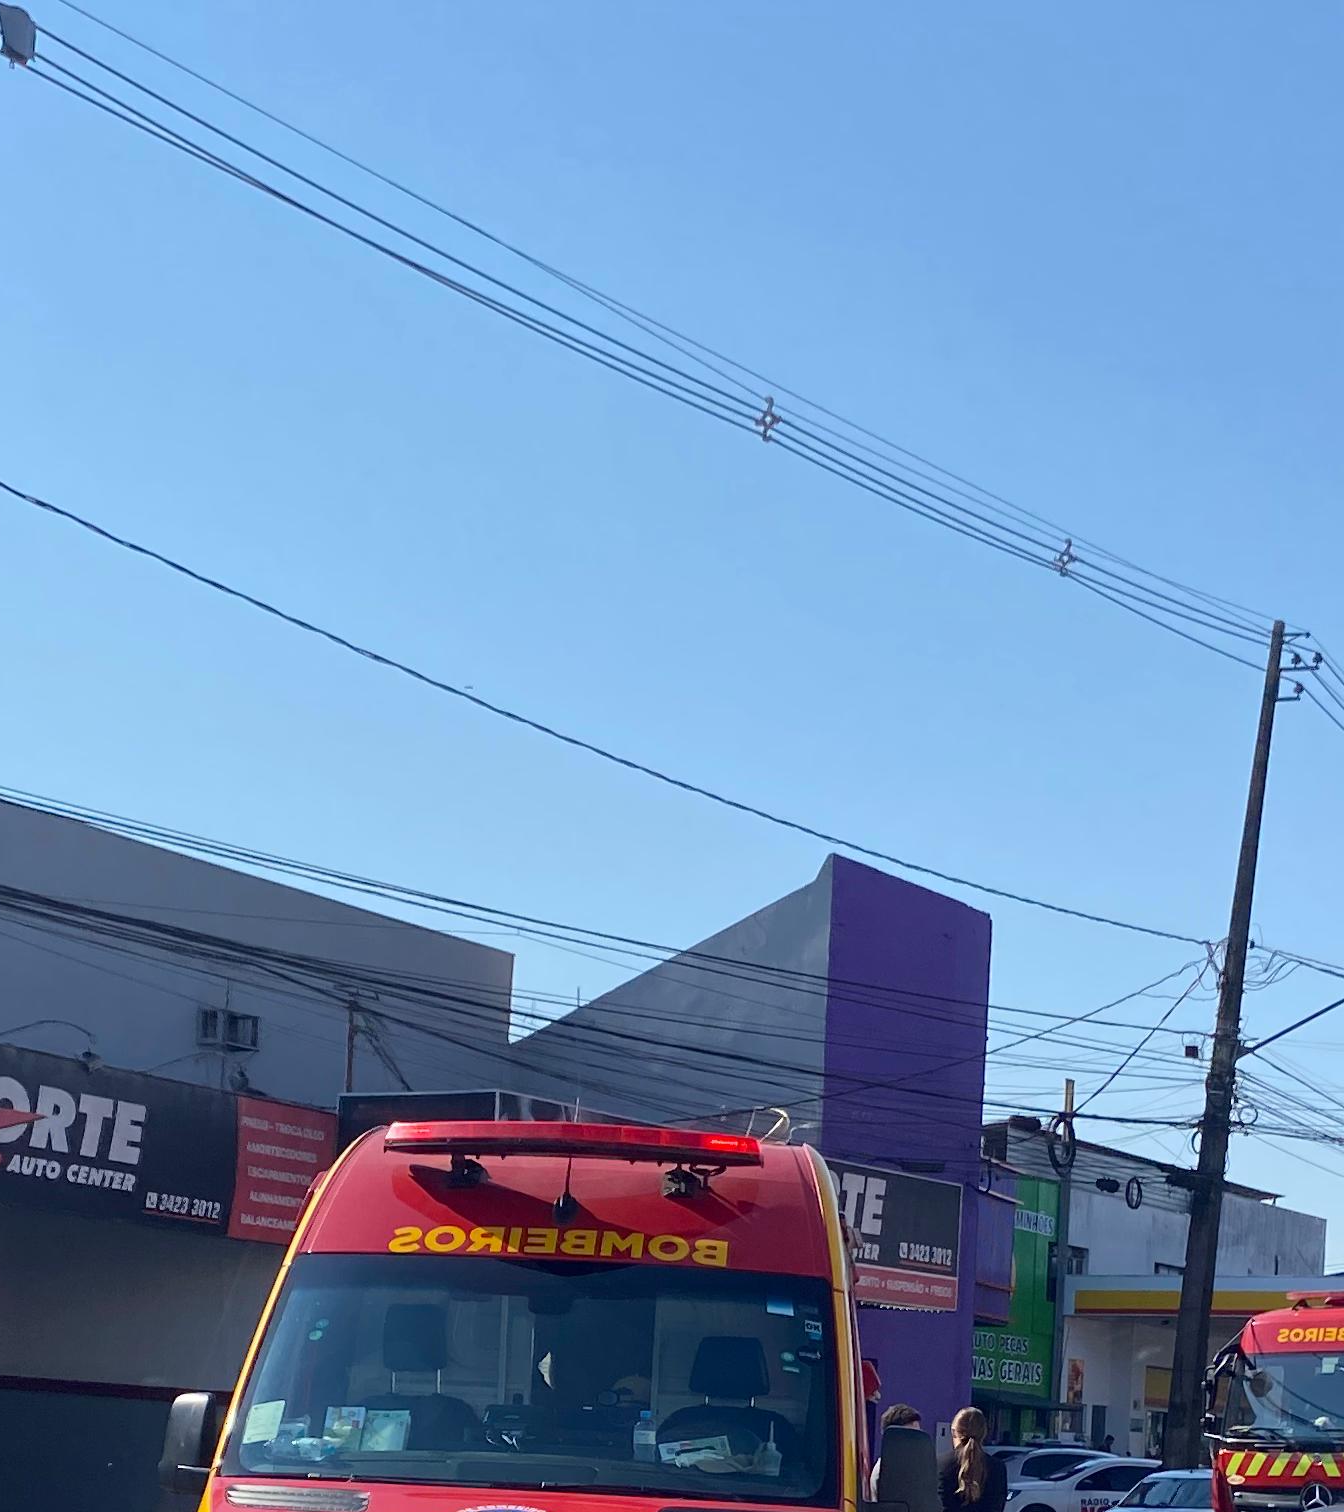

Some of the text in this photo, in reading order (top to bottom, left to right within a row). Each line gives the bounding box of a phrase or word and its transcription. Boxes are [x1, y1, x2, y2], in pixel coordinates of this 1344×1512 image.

[6, 1154, 136, 1192] AUTO CENTER
[159, 1192, 221, 1220] 3423 3012
[249, 1190, 304, 1207] ALINHAMENT
[909, 1243, 930, 1262] 3423
[999, 1359, 1043, 1386] GERAIS
